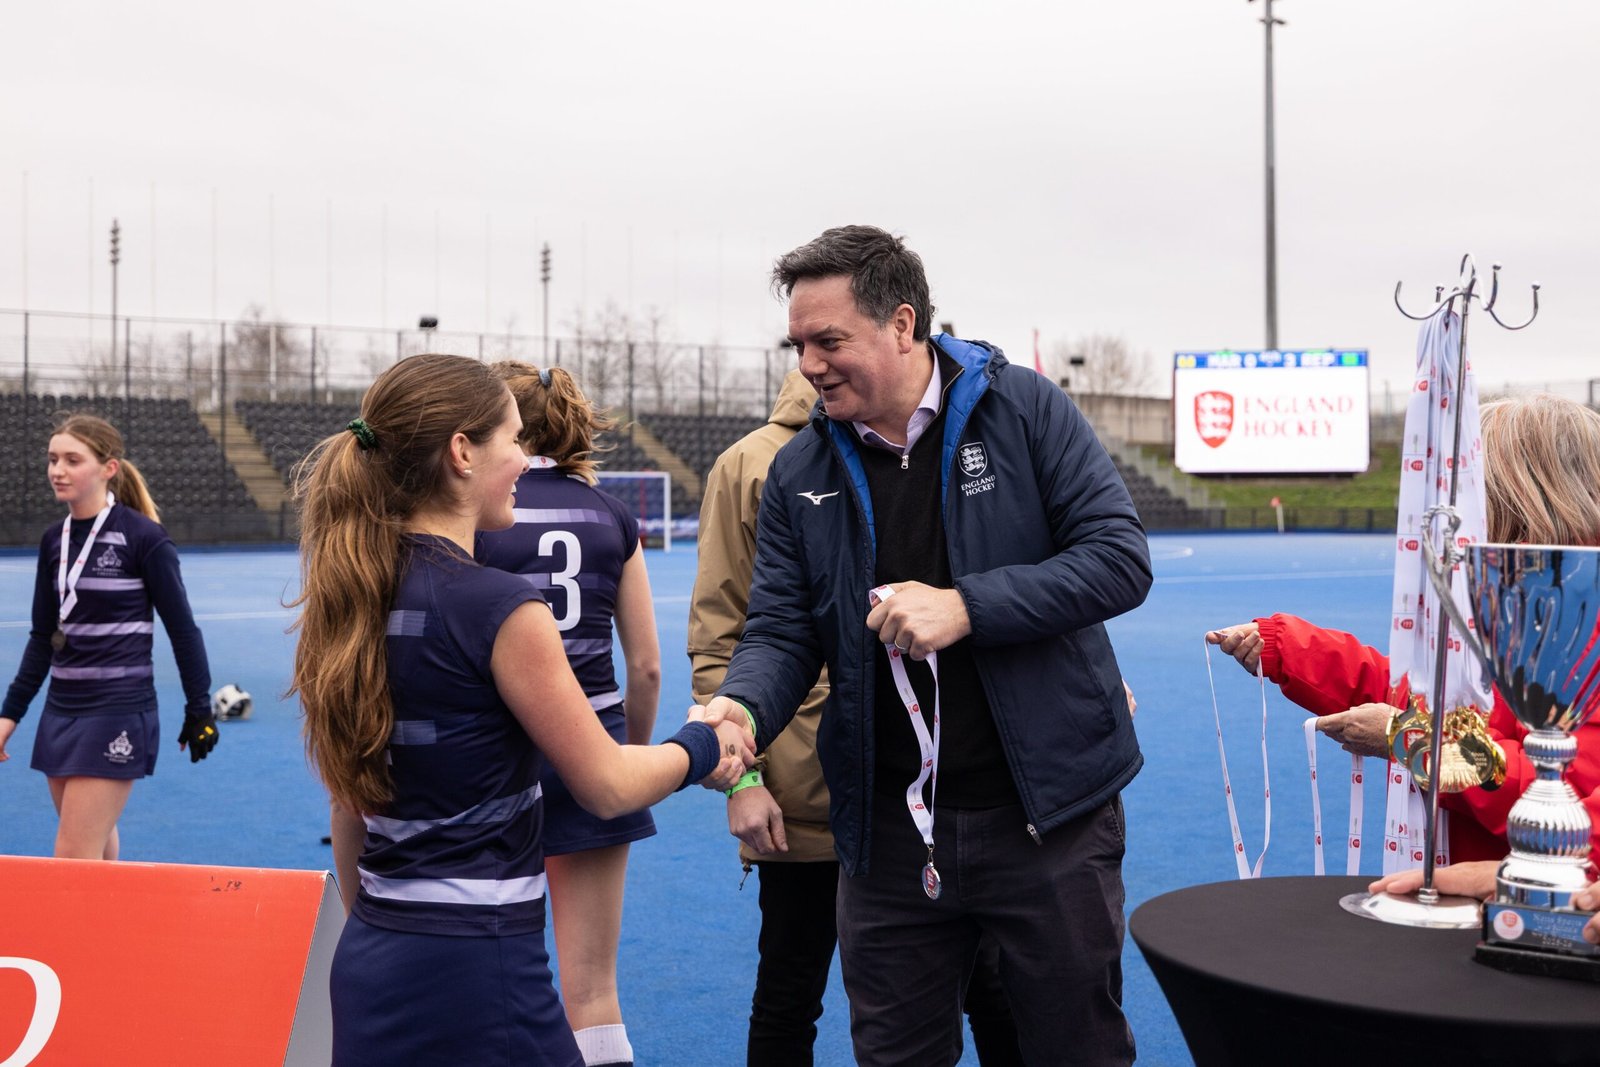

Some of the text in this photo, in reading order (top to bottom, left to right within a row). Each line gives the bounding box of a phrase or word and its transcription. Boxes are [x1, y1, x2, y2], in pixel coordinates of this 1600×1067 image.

[1243, 397, 1353, 413] ENGLAND
[1243, 420, 1333, 437] HOCKEY
[961, 475, 996, 491] ENGLAND
[965, 482, 996, 496] HOCKEY
[538, 530, 582, 631] 3
